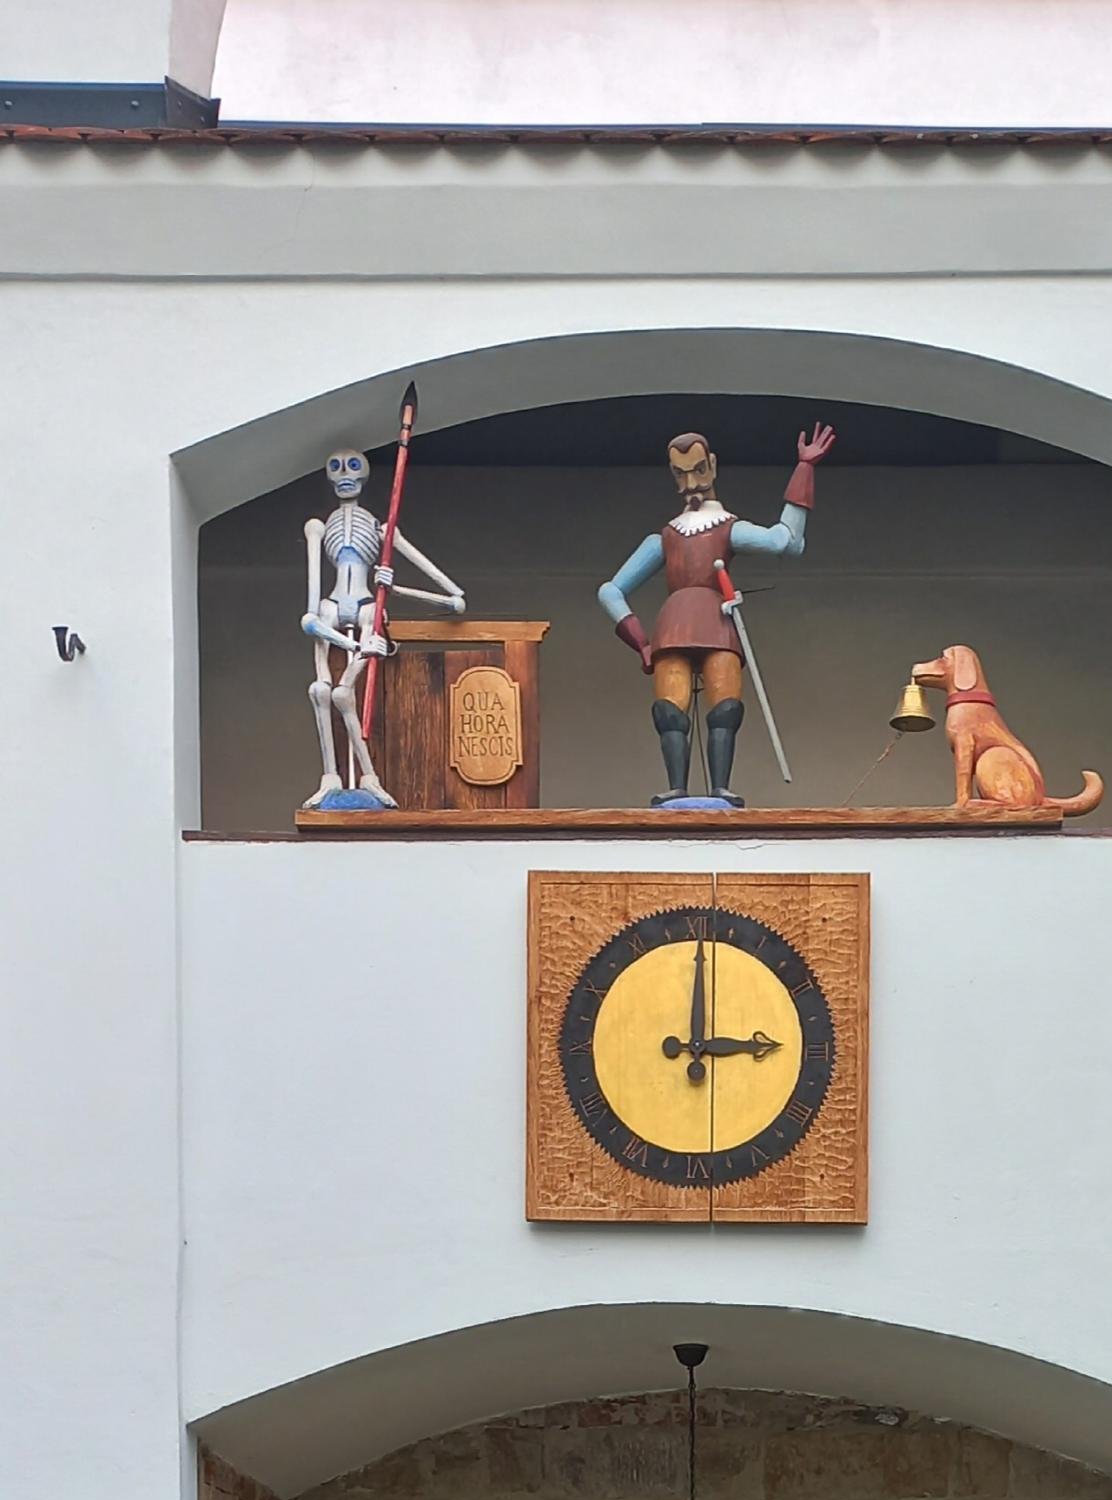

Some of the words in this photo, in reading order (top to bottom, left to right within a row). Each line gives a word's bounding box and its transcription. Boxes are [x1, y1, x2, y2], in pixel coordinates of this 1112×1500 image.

[463, 691, 505, 713] QUA
[460, 714, 510, 734] HORA
[457, 736, 513, 758] NESCIS
[790, 978, 815, 999] II
[805, 1041, 829, 1062] III
[687, 1155, 709, 1179] VI
[751, 1145, 770, 1168] V
